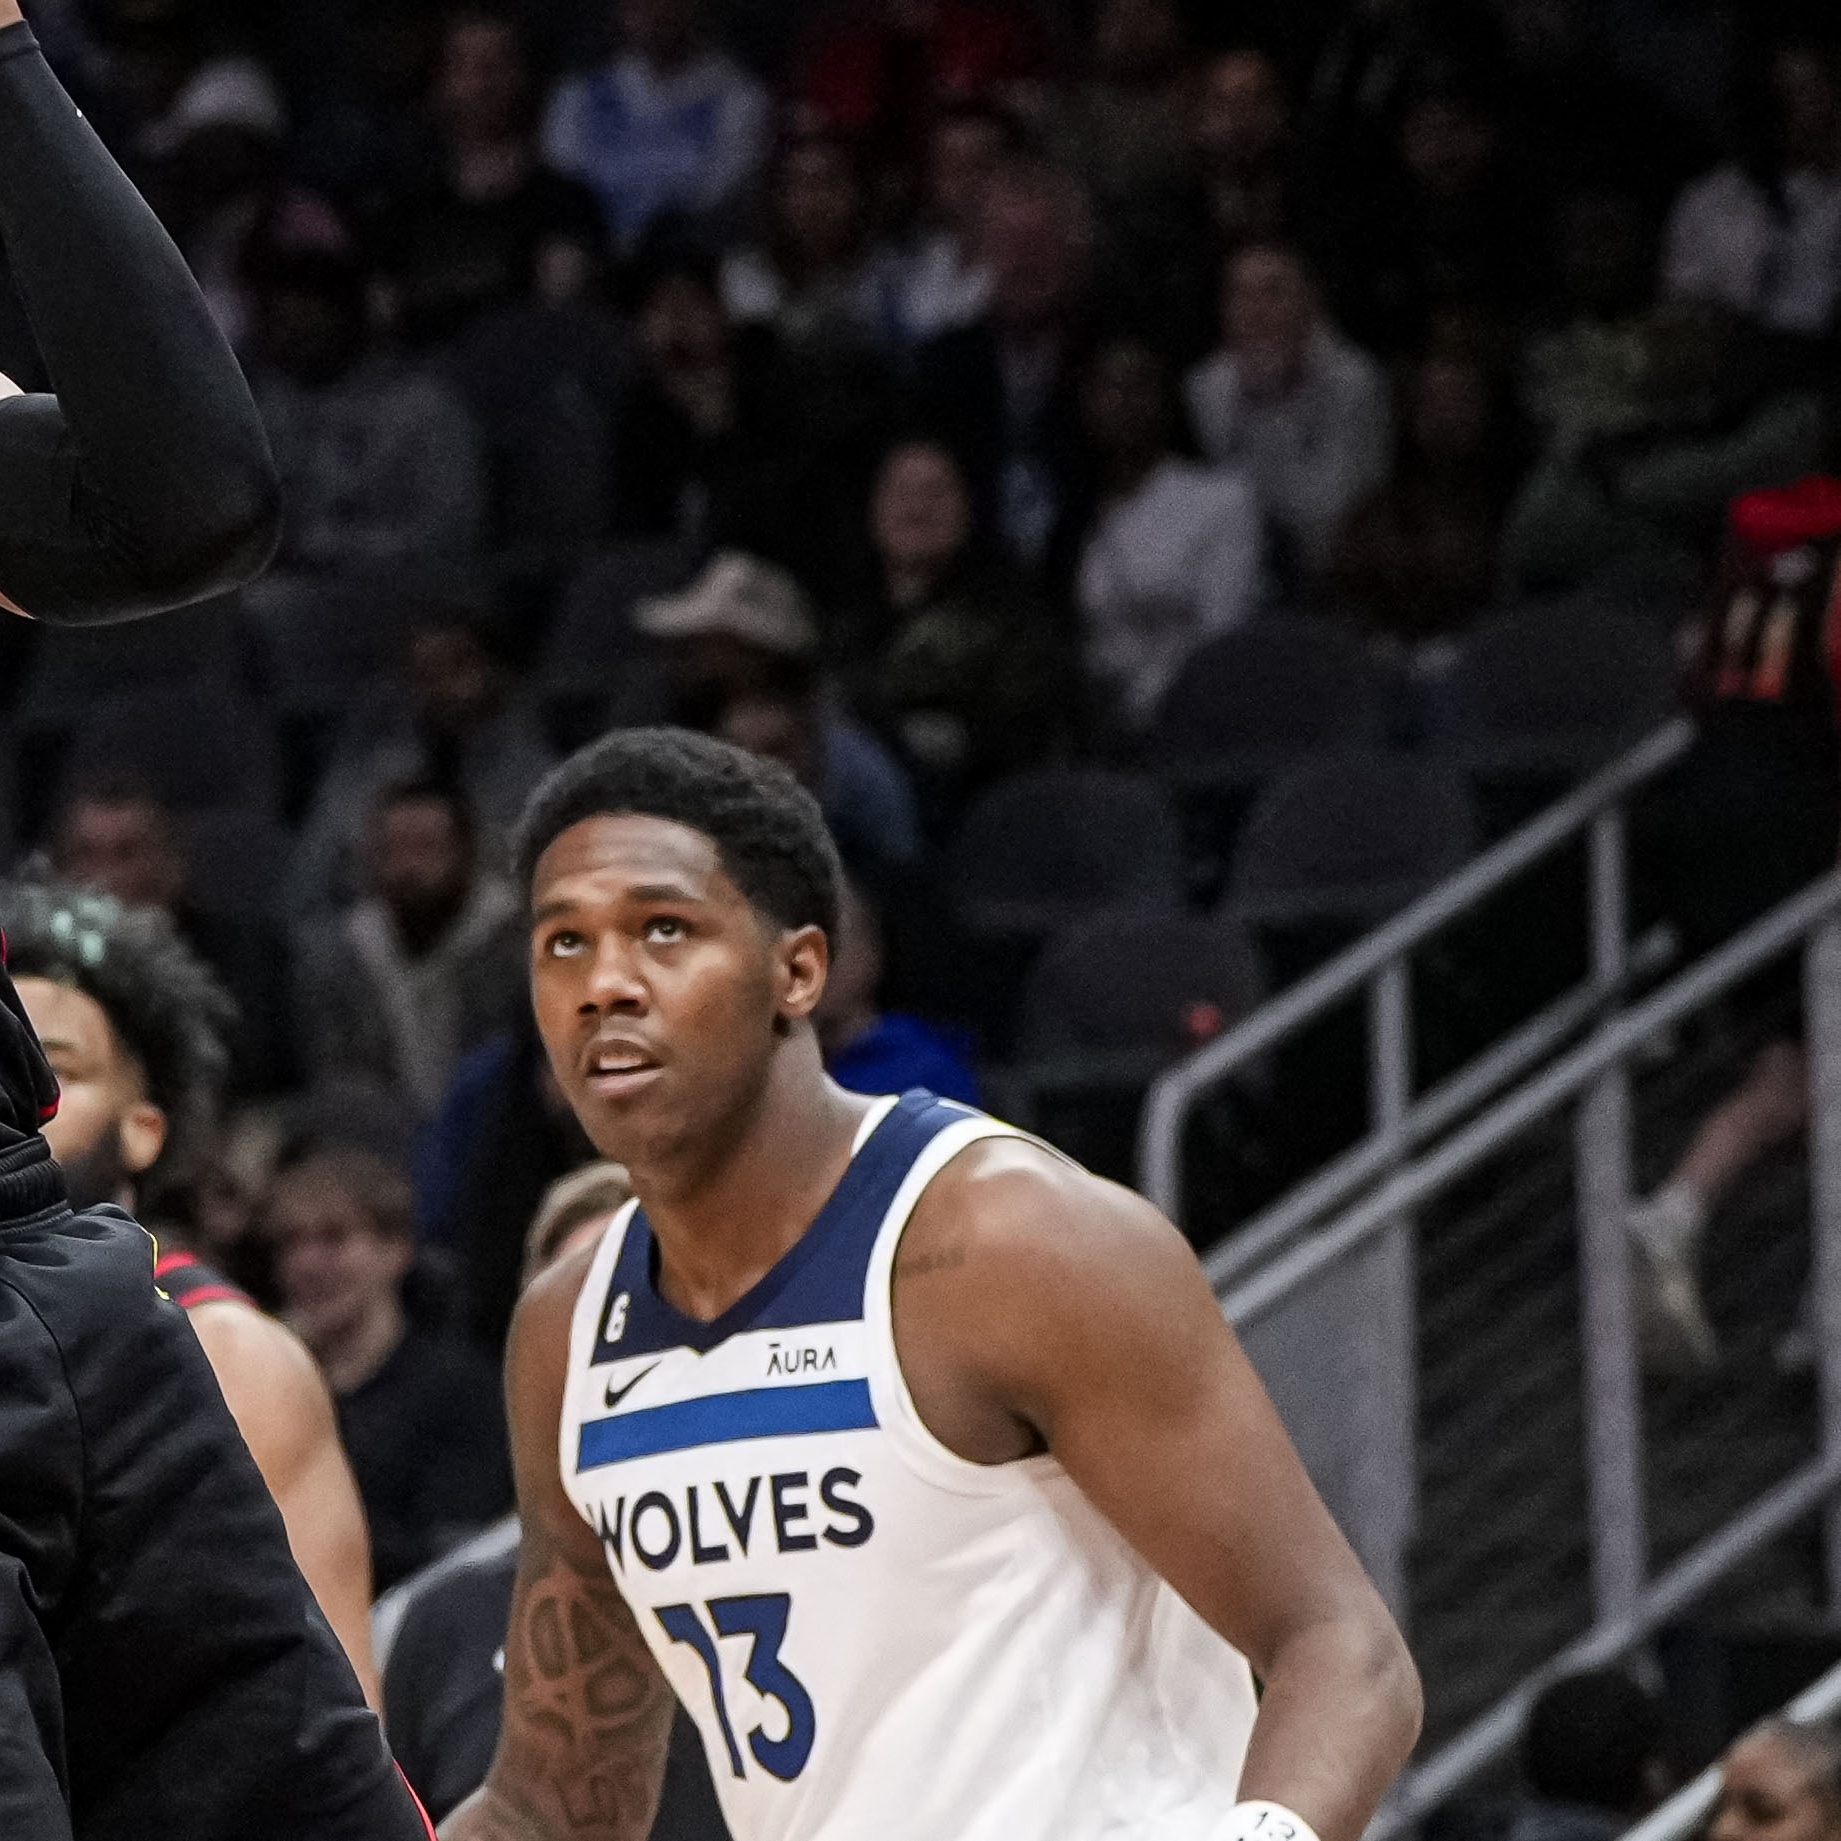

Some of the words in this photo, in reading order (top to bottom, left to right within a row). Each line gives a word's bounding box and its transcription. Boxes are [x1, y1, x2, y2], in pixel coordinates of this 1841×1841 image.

[603, 1291, 632, 1344] 6
[585, 1466, 875, 1577] WOLVES
[652, 1592, 816, 1783] 13
